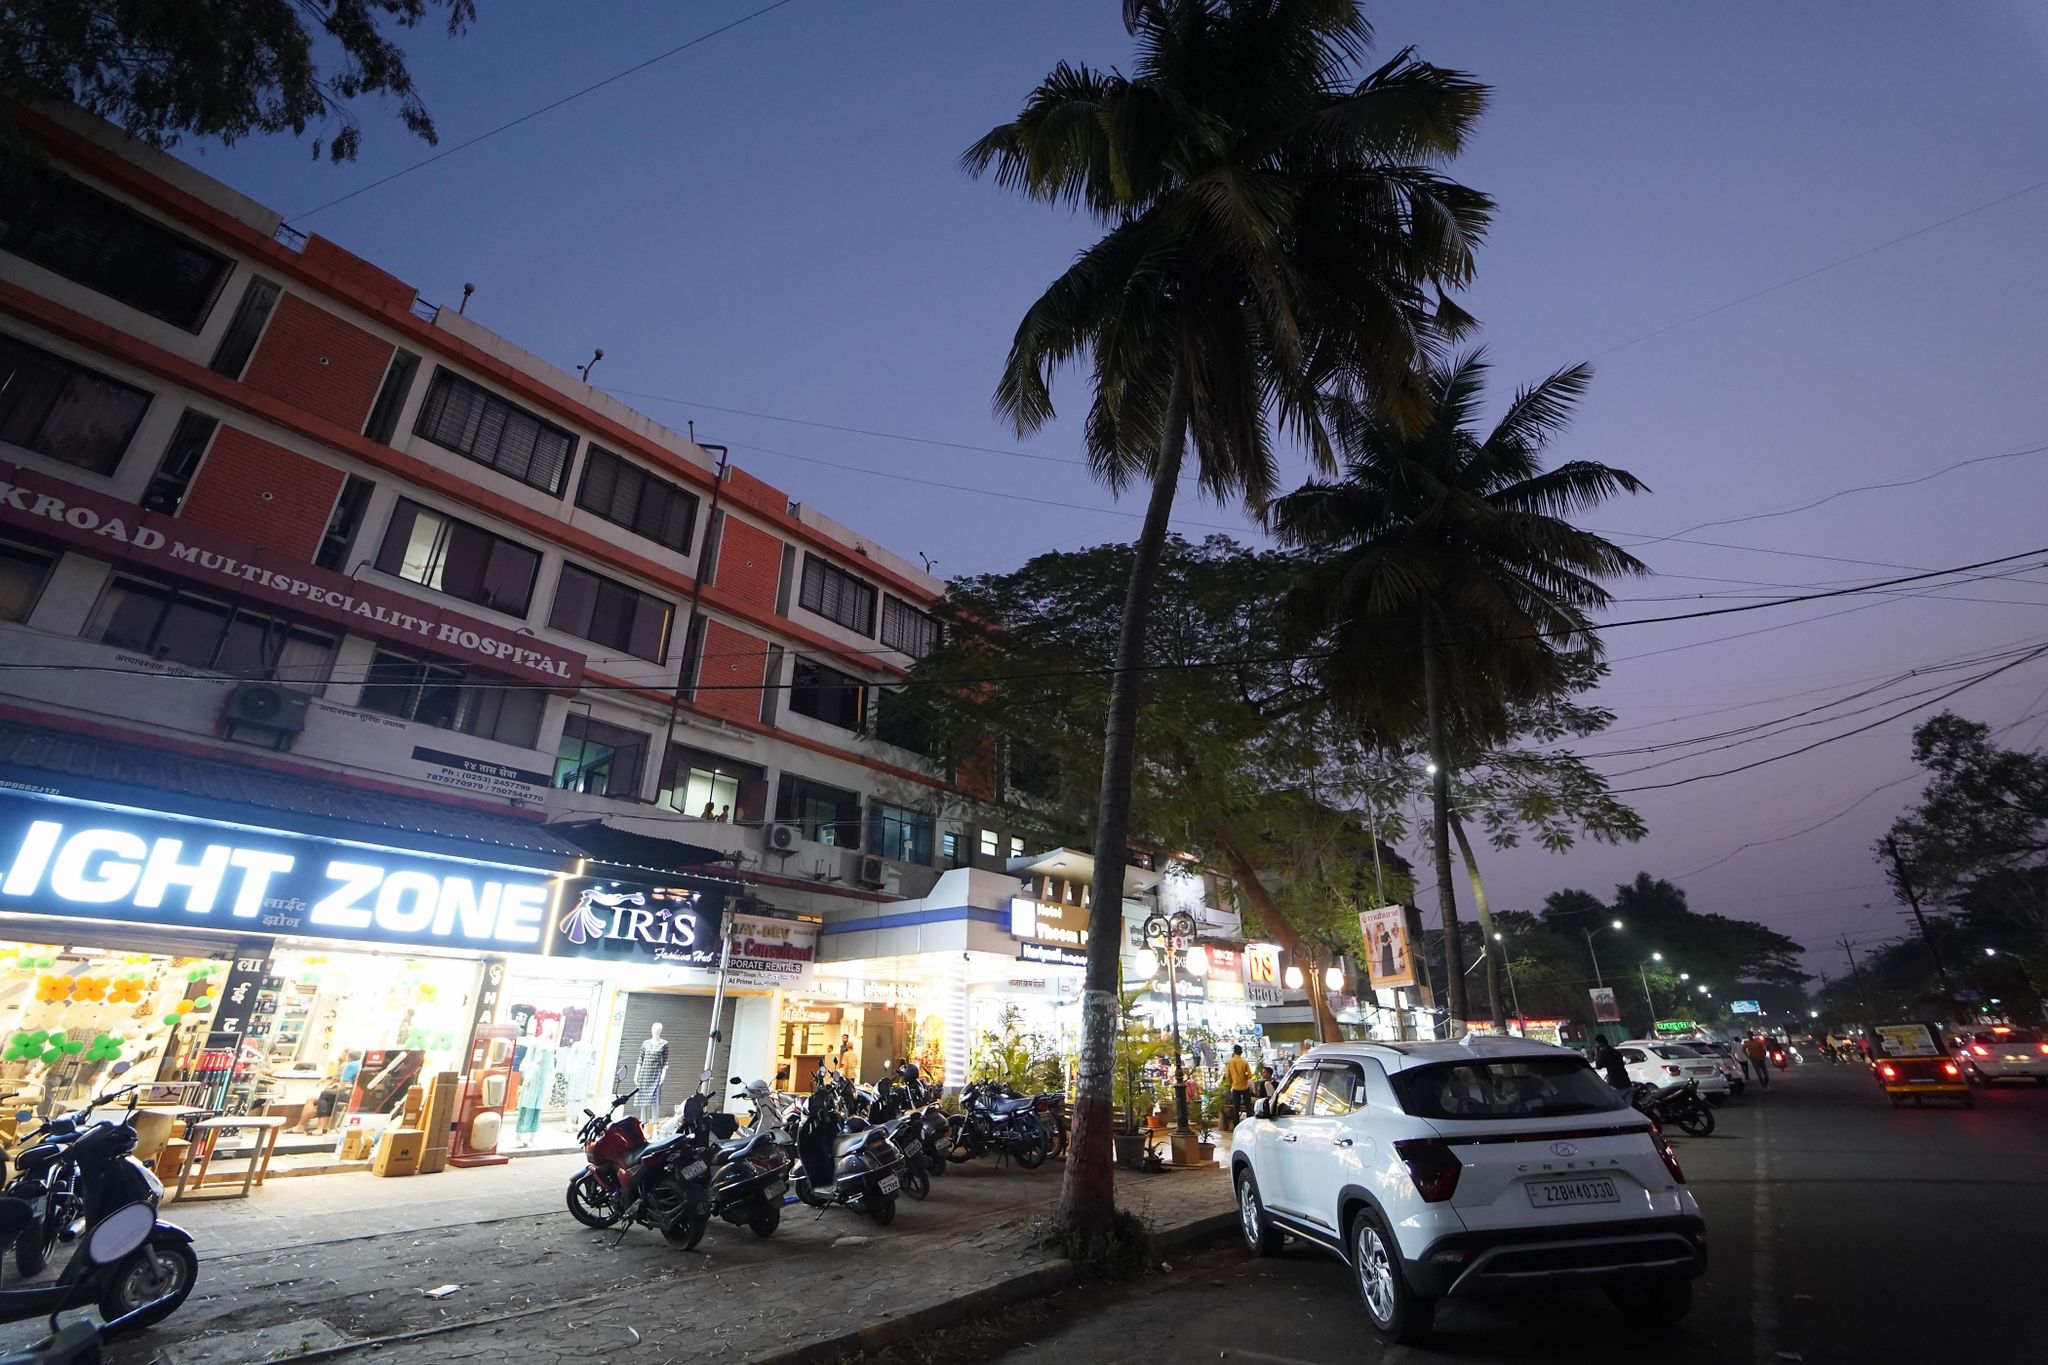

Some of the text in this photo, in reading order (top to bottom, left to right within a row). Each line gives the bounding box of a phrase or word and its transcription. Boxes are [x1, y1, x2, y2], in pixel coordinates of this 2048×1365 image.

[169, 541, 436, 636] MULTISPECIALITY
[437, 622, 572, 679] HOSPITAL
[0, 819, 549, 944] IGHT ZONE
[653, 948, 714, 963] Fashion Hub
[764, 961, 801, 974] RENTALS
[1249, 949, 1276, 984] DS
[1518, 1158, 1619, 1172] CRETA
